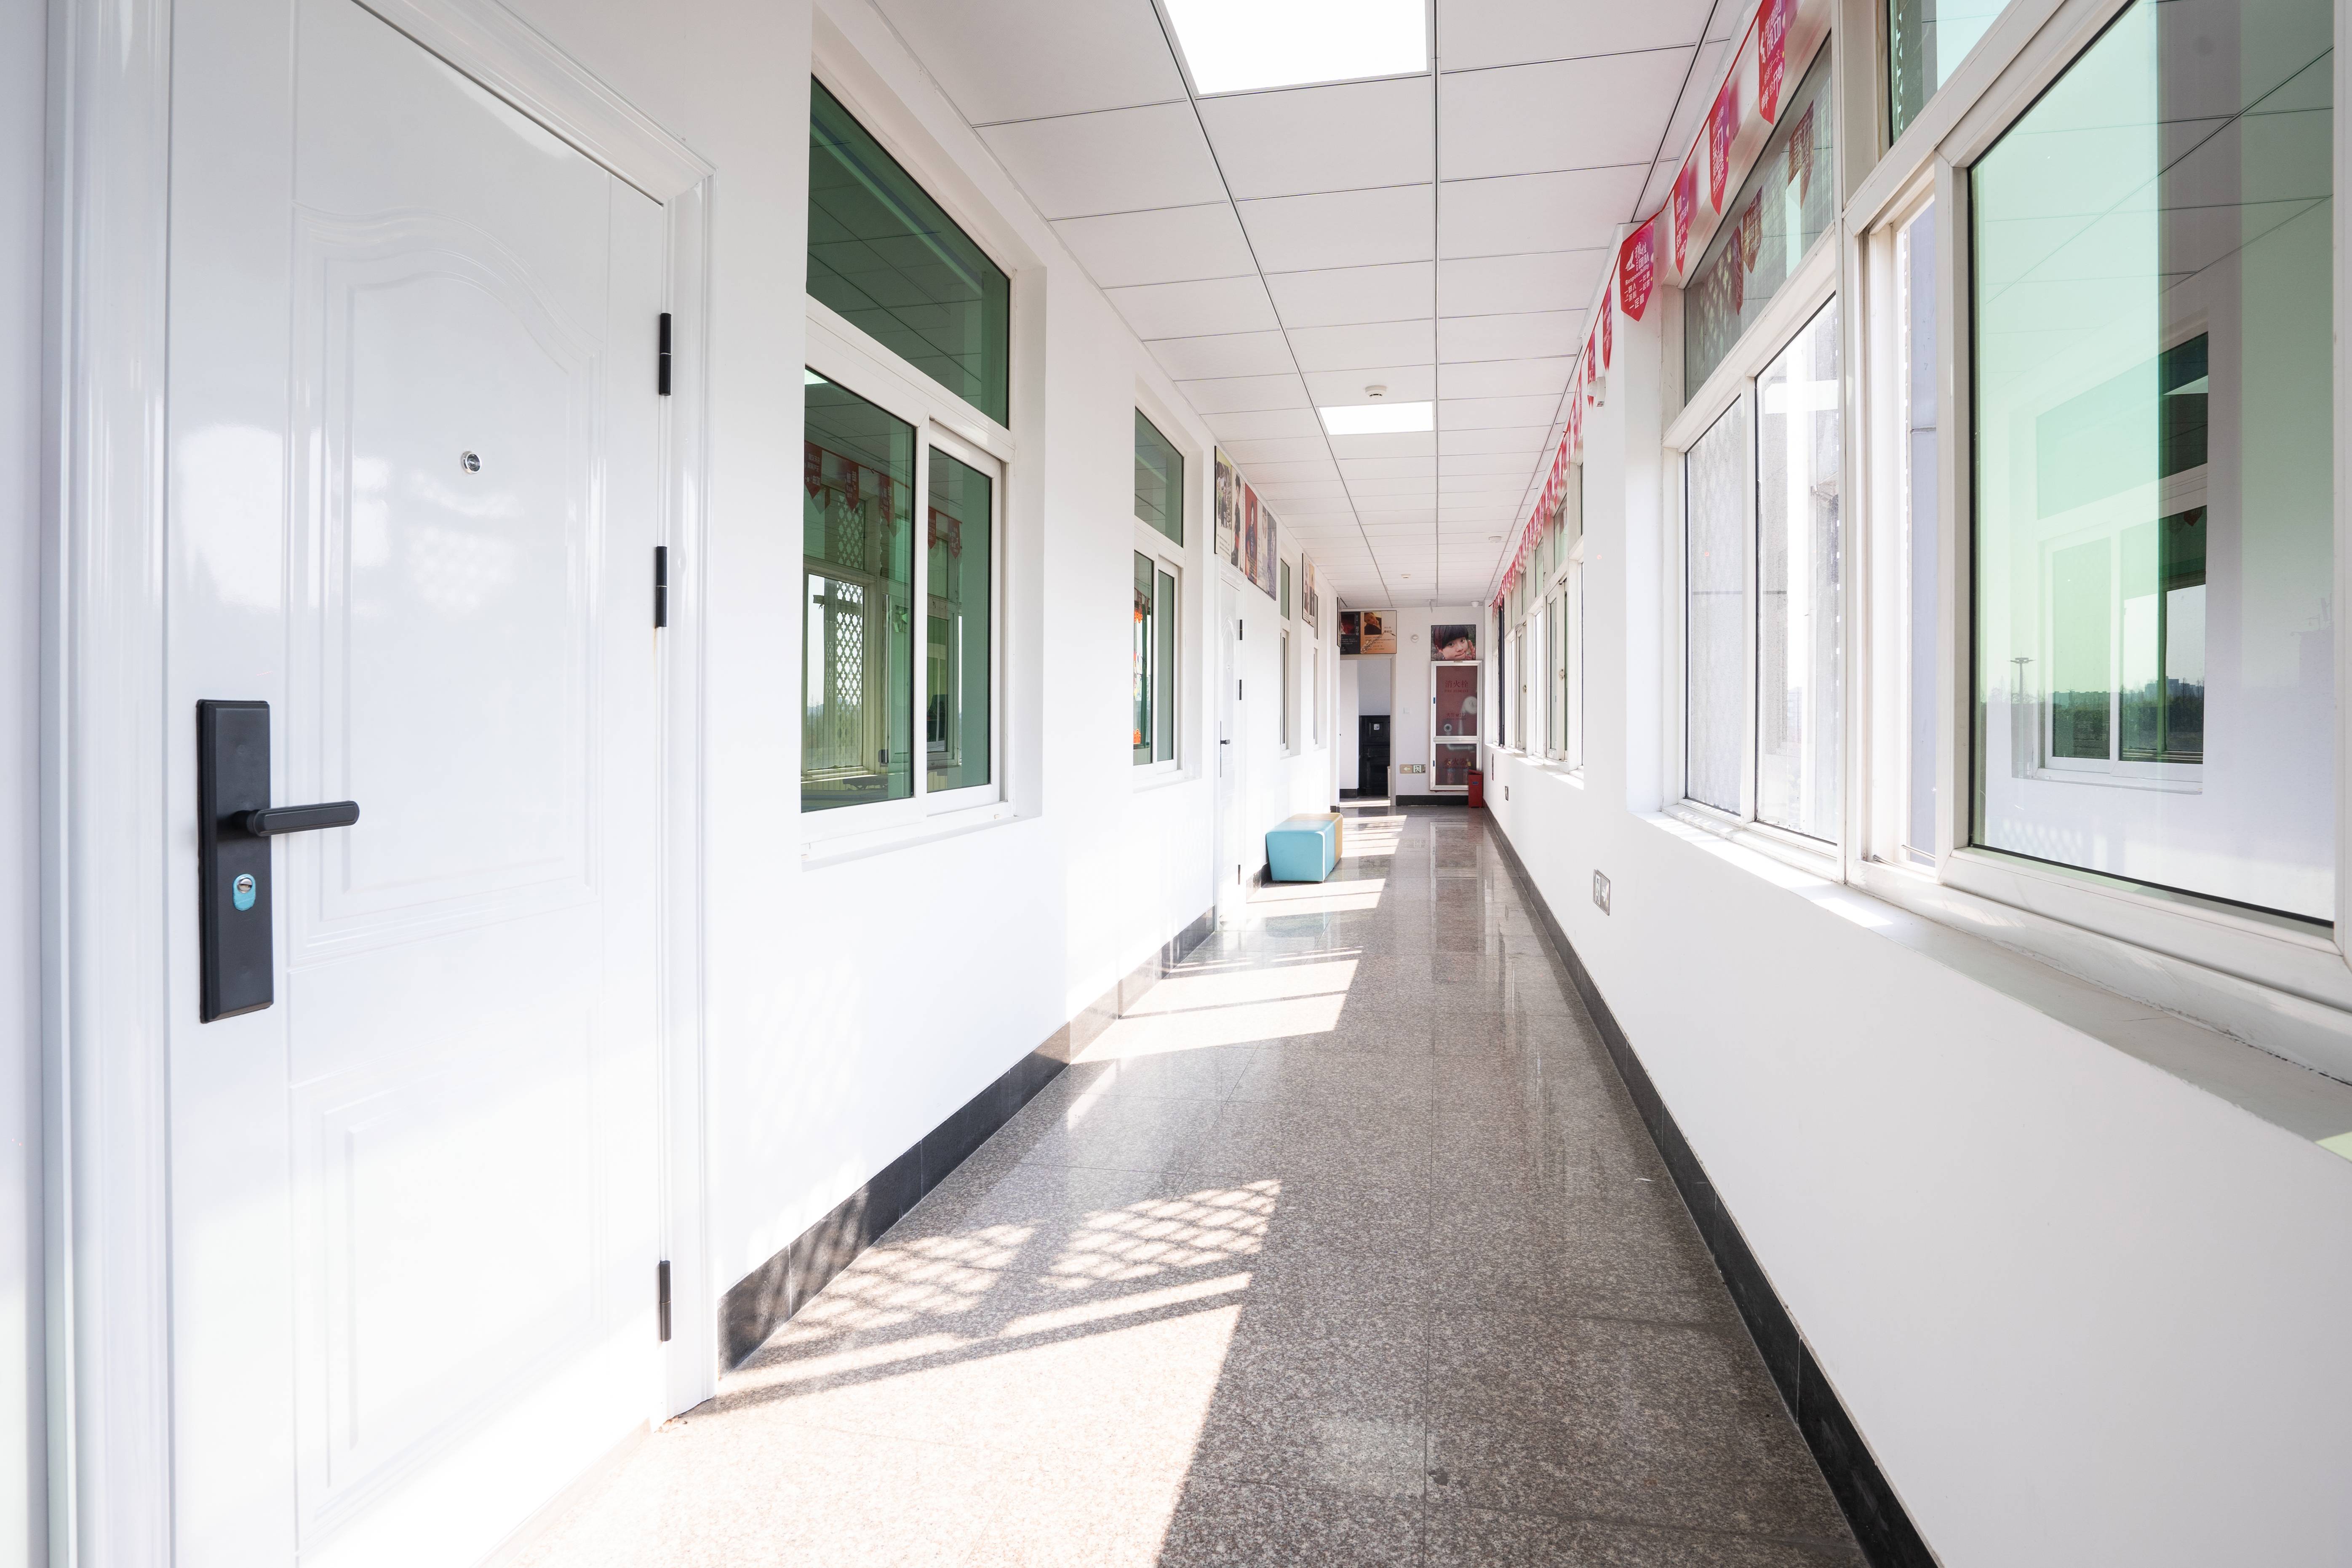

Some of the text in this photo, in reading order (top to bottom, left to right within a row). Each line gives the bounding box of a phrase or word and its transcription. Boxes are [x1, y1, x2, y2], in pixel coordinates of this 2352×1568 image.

[1767, 15, 1781, 58] 成功
[1713, 125, 1723, 165] 实力
[1634, 242, 1647, 259] 狼性
[1639, 252, 1650, 269] 团队
[1626, 263, 1649, 286] Responsibility
[1624, 283, 1637, 294] 一群人
[1629, 293, 1645, 309] 一定赢
